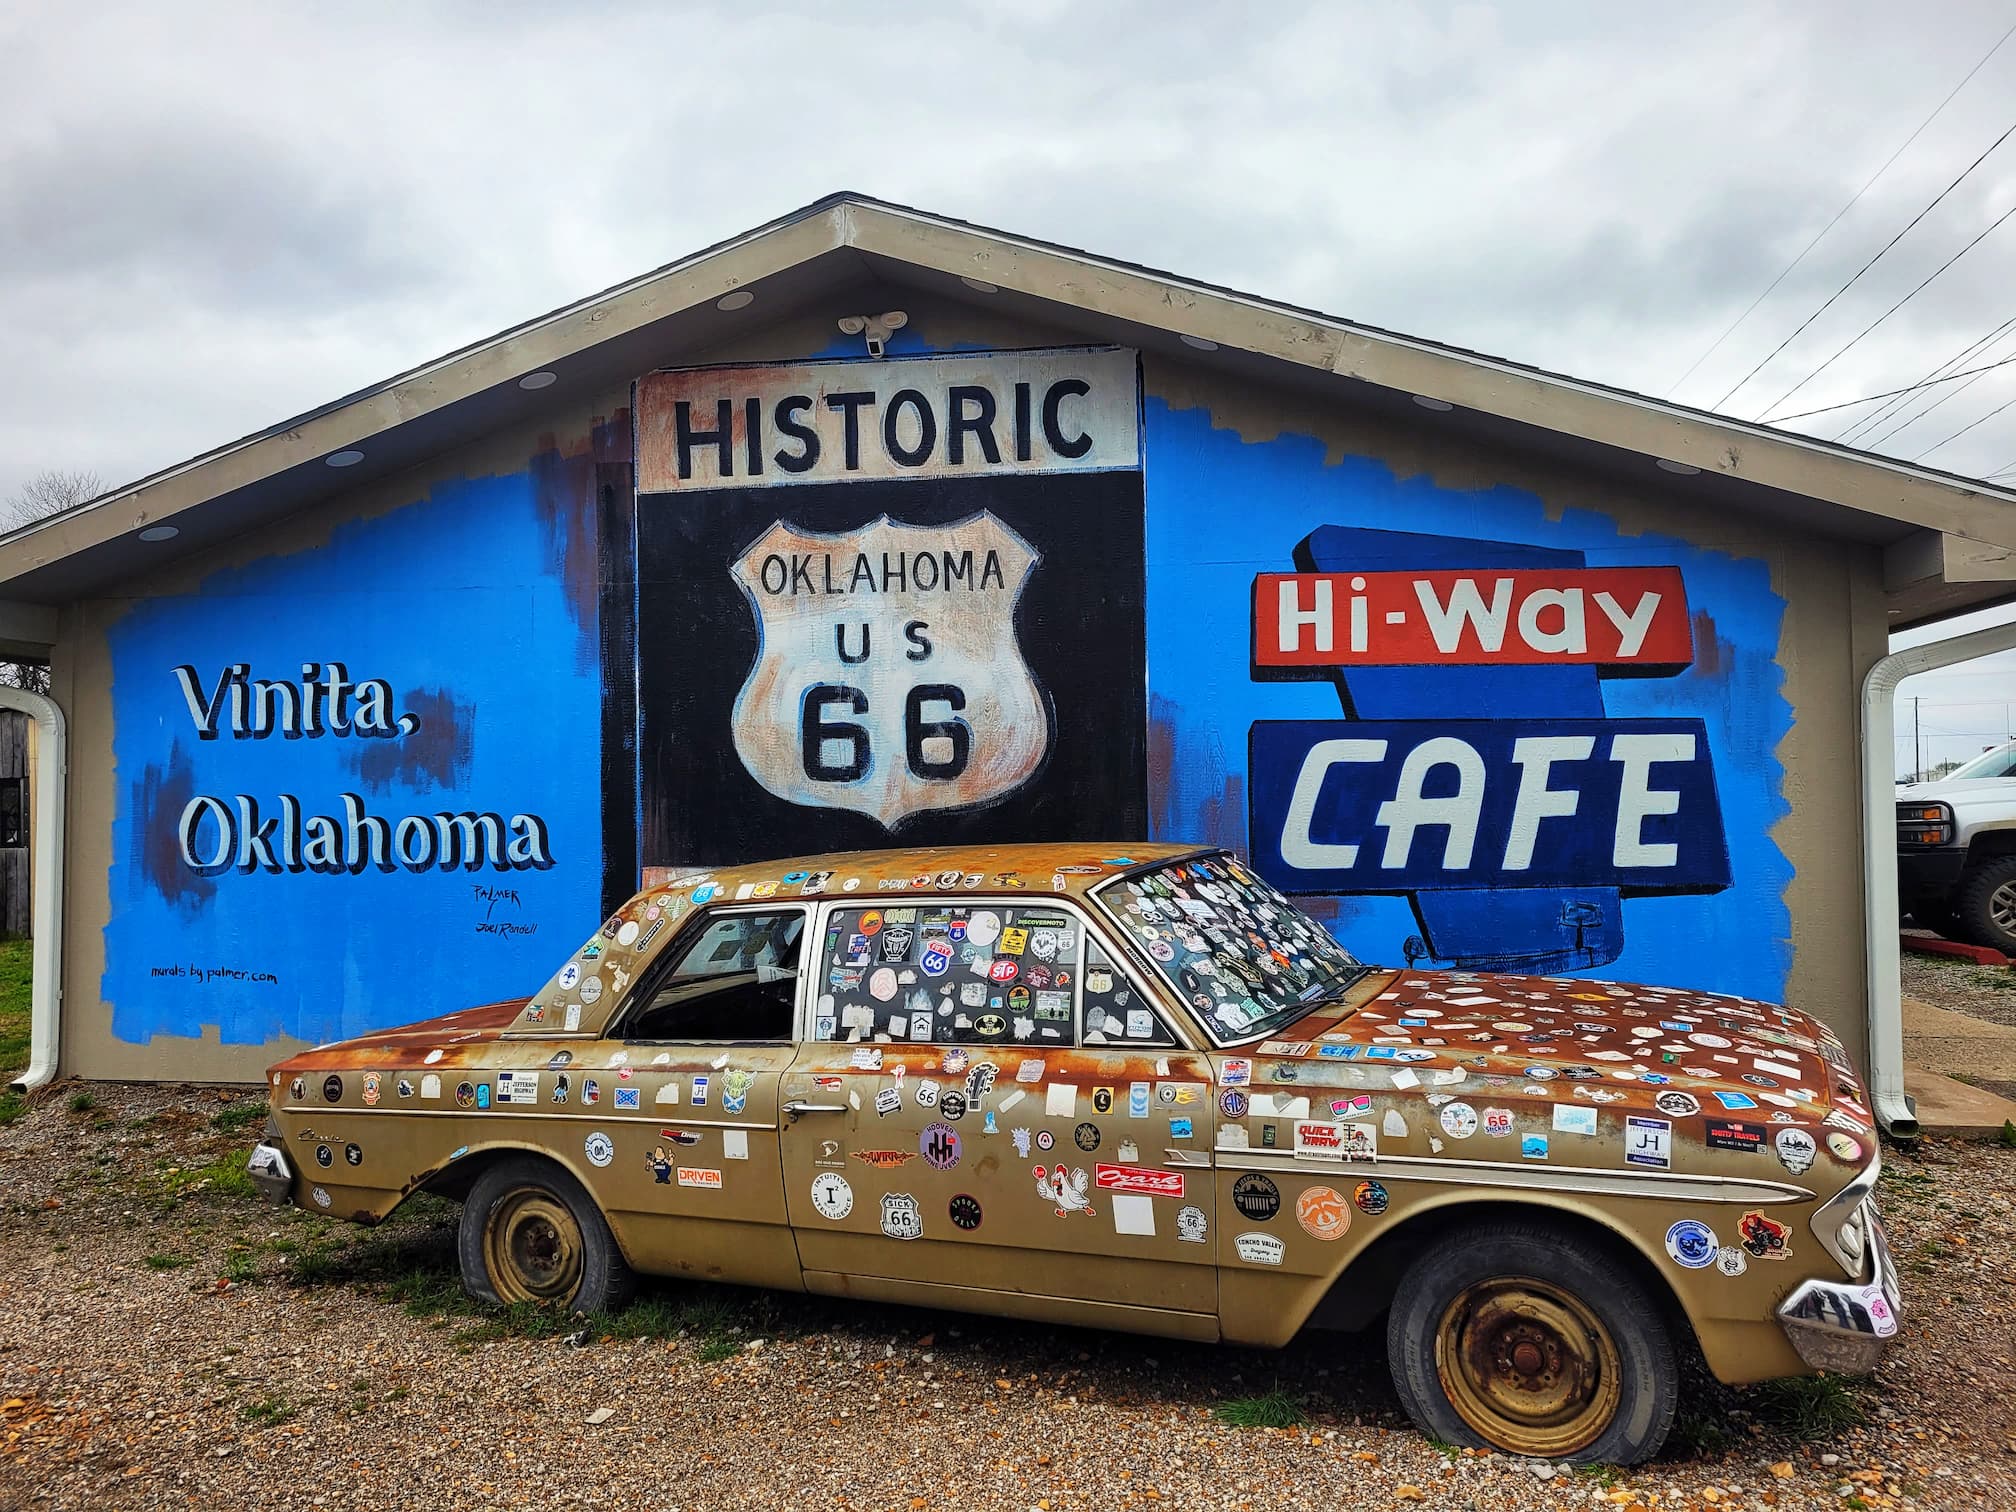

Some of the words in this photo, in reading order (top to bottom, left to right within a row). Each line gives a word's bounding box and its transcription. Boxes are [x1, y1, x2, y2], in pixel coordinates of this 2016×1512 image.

[675, 379, 1093, 479] HISTORIC
[761, 550, 1005, 595] OKLAHOMA
[1279, 577, 1662, 657] Hi-Way
[836, 622, 871, 664] U
[904, 621, 932, 661] S
[171, 662, 421, 740] Vinita,
[802, 683, 973, 783] 66
[1281, 734, 1696, 870] CAFE
[178, 792, 558, 876] Oklahoma
[471, 884, 521, 919] PALMER
[475, 922, 498, 933] Joel
[929, 942, 951, 956] FIFTY
[925, 953, 944, 970] 66
[992, 962, 1015, 978] STP
[151, 964, 186, 977] murals
[190, 963, 204, 983] by
[919, 1089, 935, 1103] 66
[1487, 1115, 1508, 1127] 66
[679, 1169, 720, 1182] DRIVEN
[888, 1200, 910, 1208] SICK
[891, 1211, 911, 1226] 66
